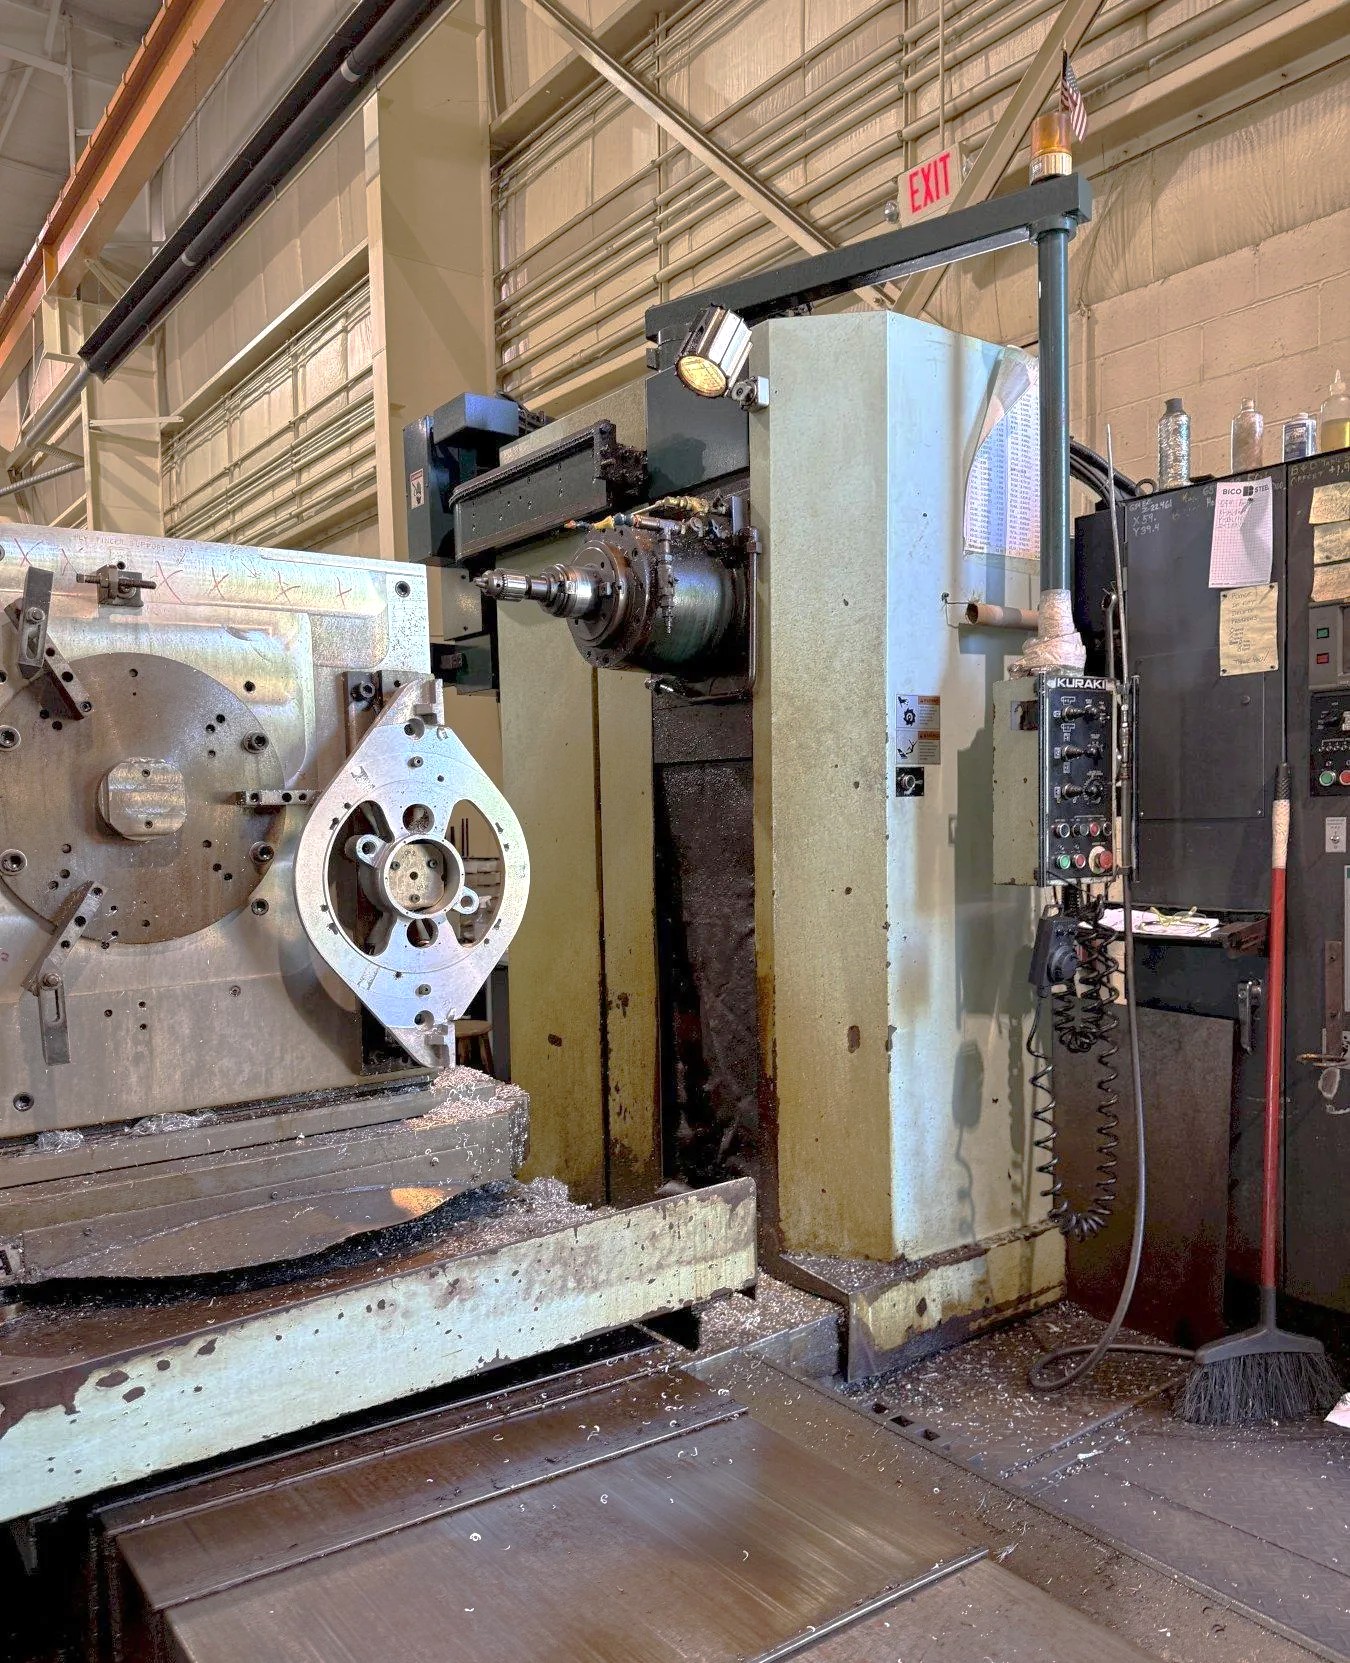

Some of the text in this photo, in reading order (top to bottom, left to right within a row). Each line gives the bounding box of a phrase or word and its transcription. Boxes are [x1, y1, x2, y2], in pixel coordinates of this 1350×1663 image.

[909, 152, 951, 214] EXIT
[1254, 484, 1270, 494] STEEL
[1057, 677, 1107, 689] KURAKI
